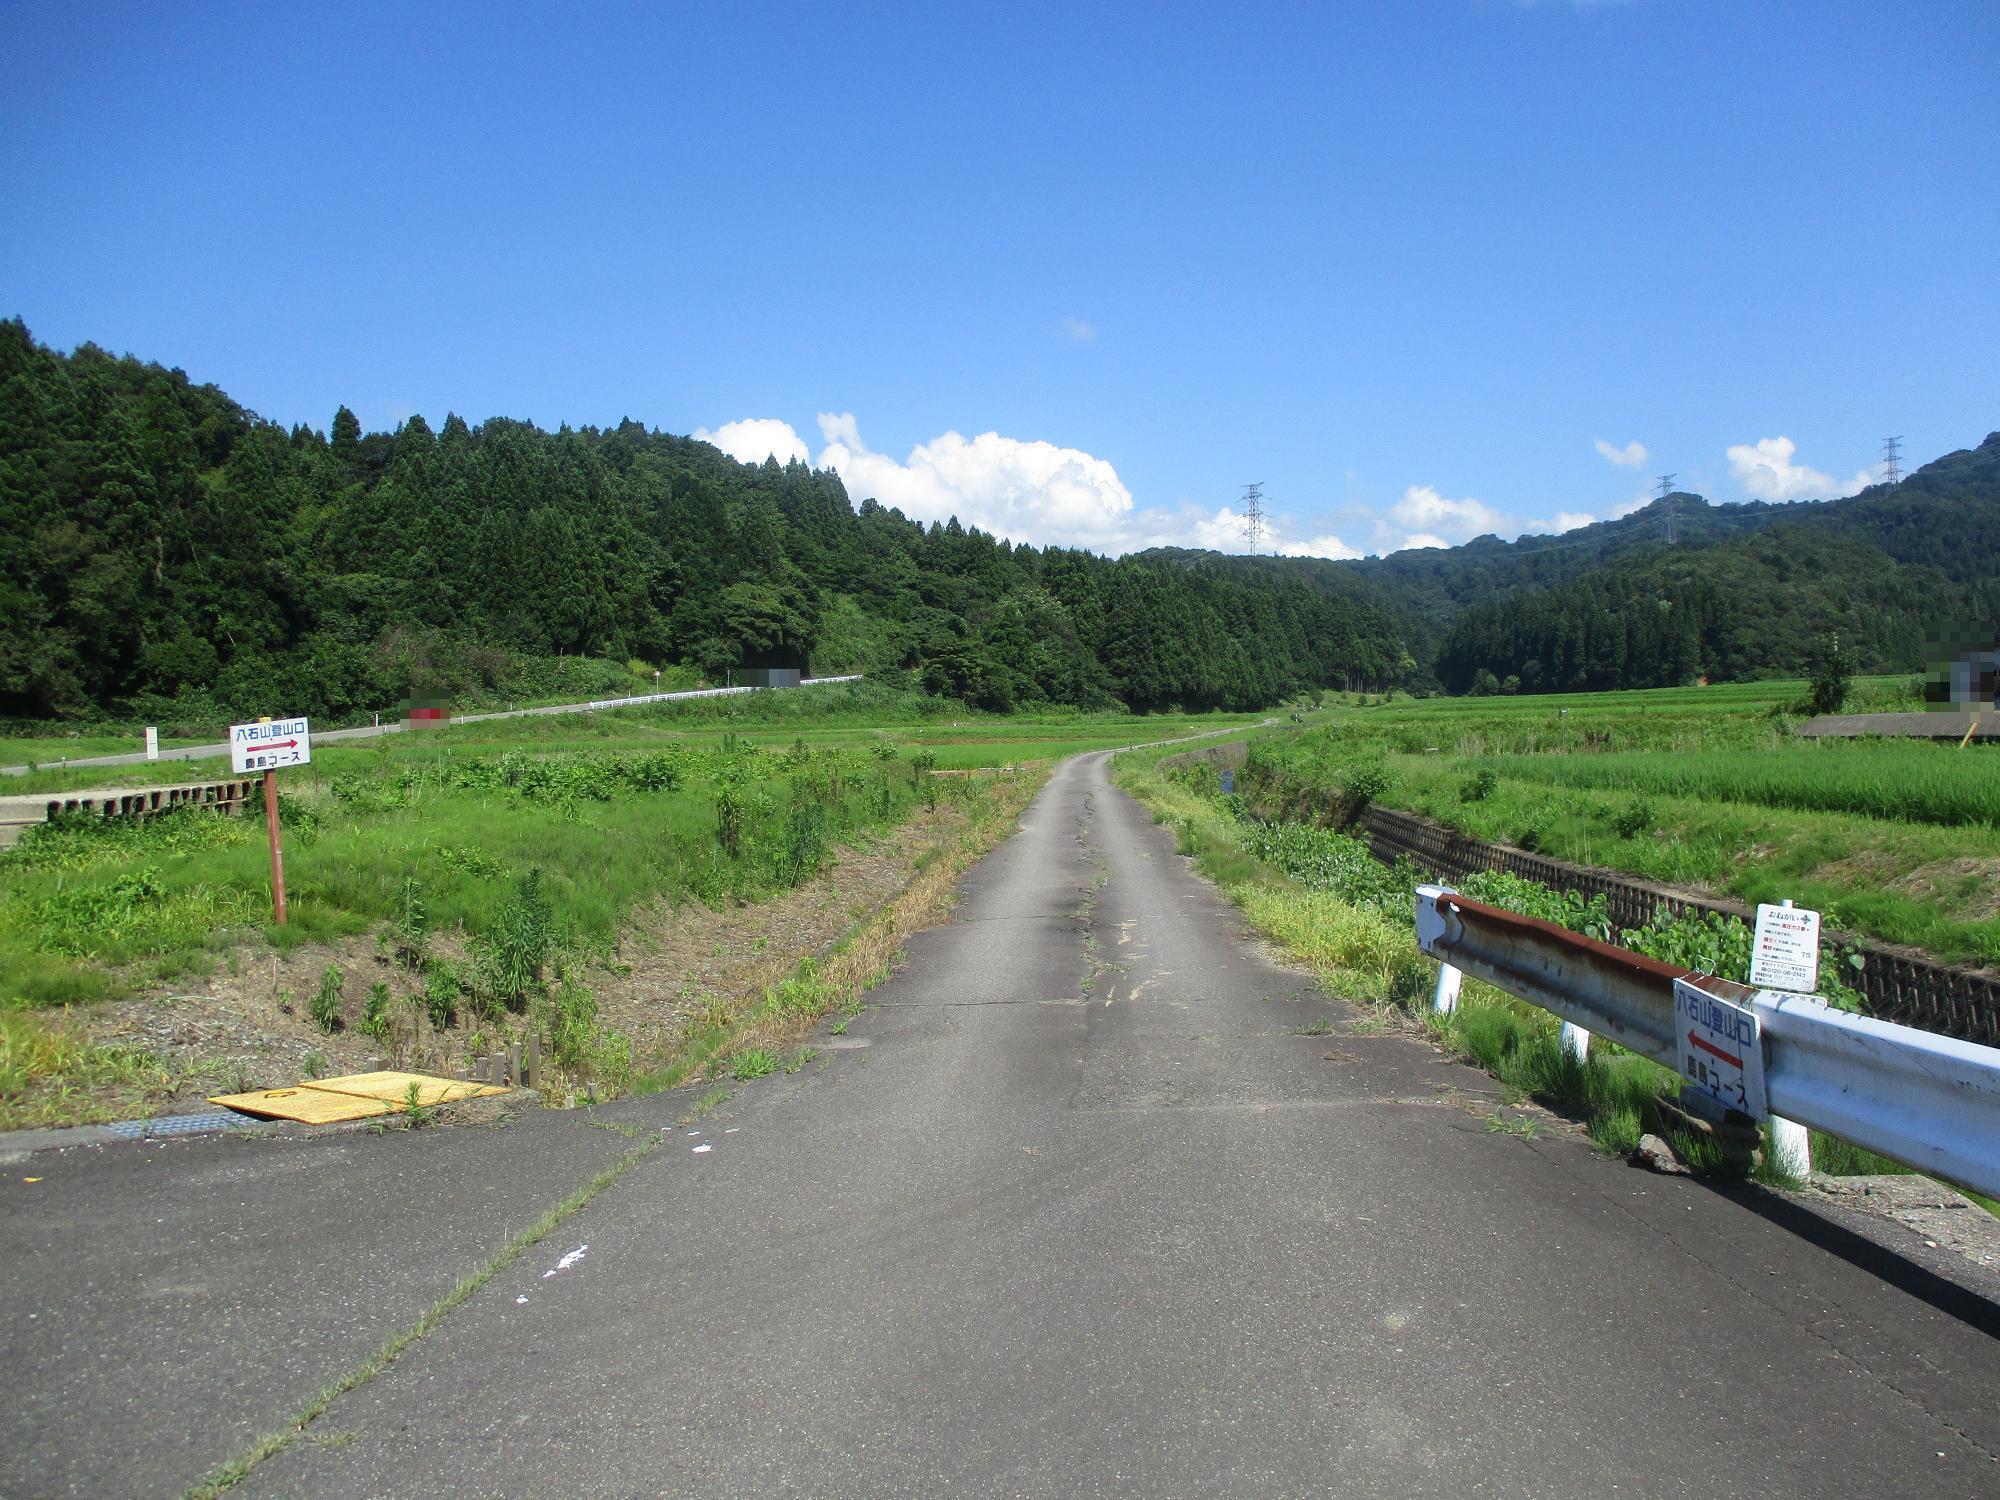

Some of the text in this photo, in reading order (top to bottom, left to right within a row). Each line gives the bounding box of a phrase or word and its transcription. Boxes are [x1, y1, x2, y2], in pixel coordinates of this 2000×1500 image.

[236, 722, 305, 741] 八石山登山口
[1677, 990, 1752, 1048] 八石山登山口
